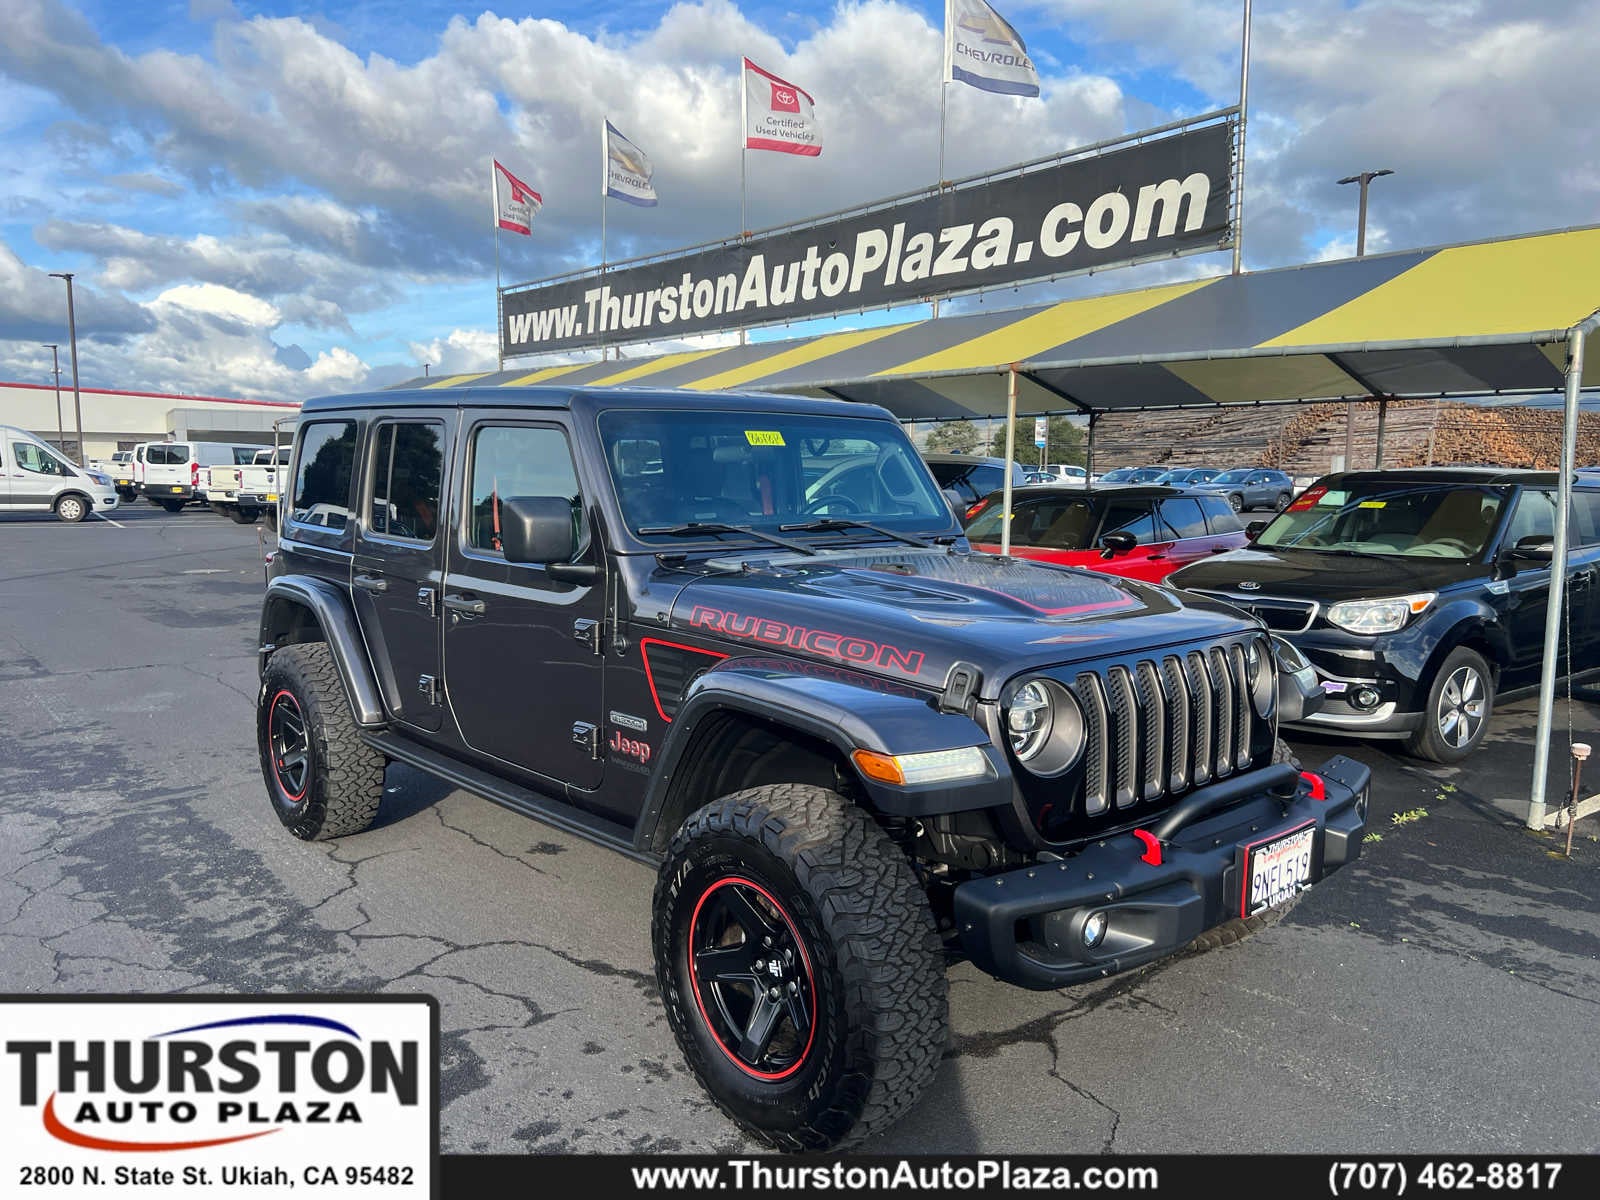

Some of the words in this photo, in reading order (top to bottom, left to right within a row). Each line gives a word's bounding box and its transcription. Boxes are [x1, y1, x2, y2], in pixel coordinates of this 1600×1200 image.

[755, 125, 777, 136] Used
[780, 129, 815, 141] Vehicles
[766, 116, 804, 128] Certified
[508, 172, 1210, 345] www.ThurstonAutoPlaza.com
[690, 605, 925, 676] RUBICON
[609, 730, 651, 765] Jeep
